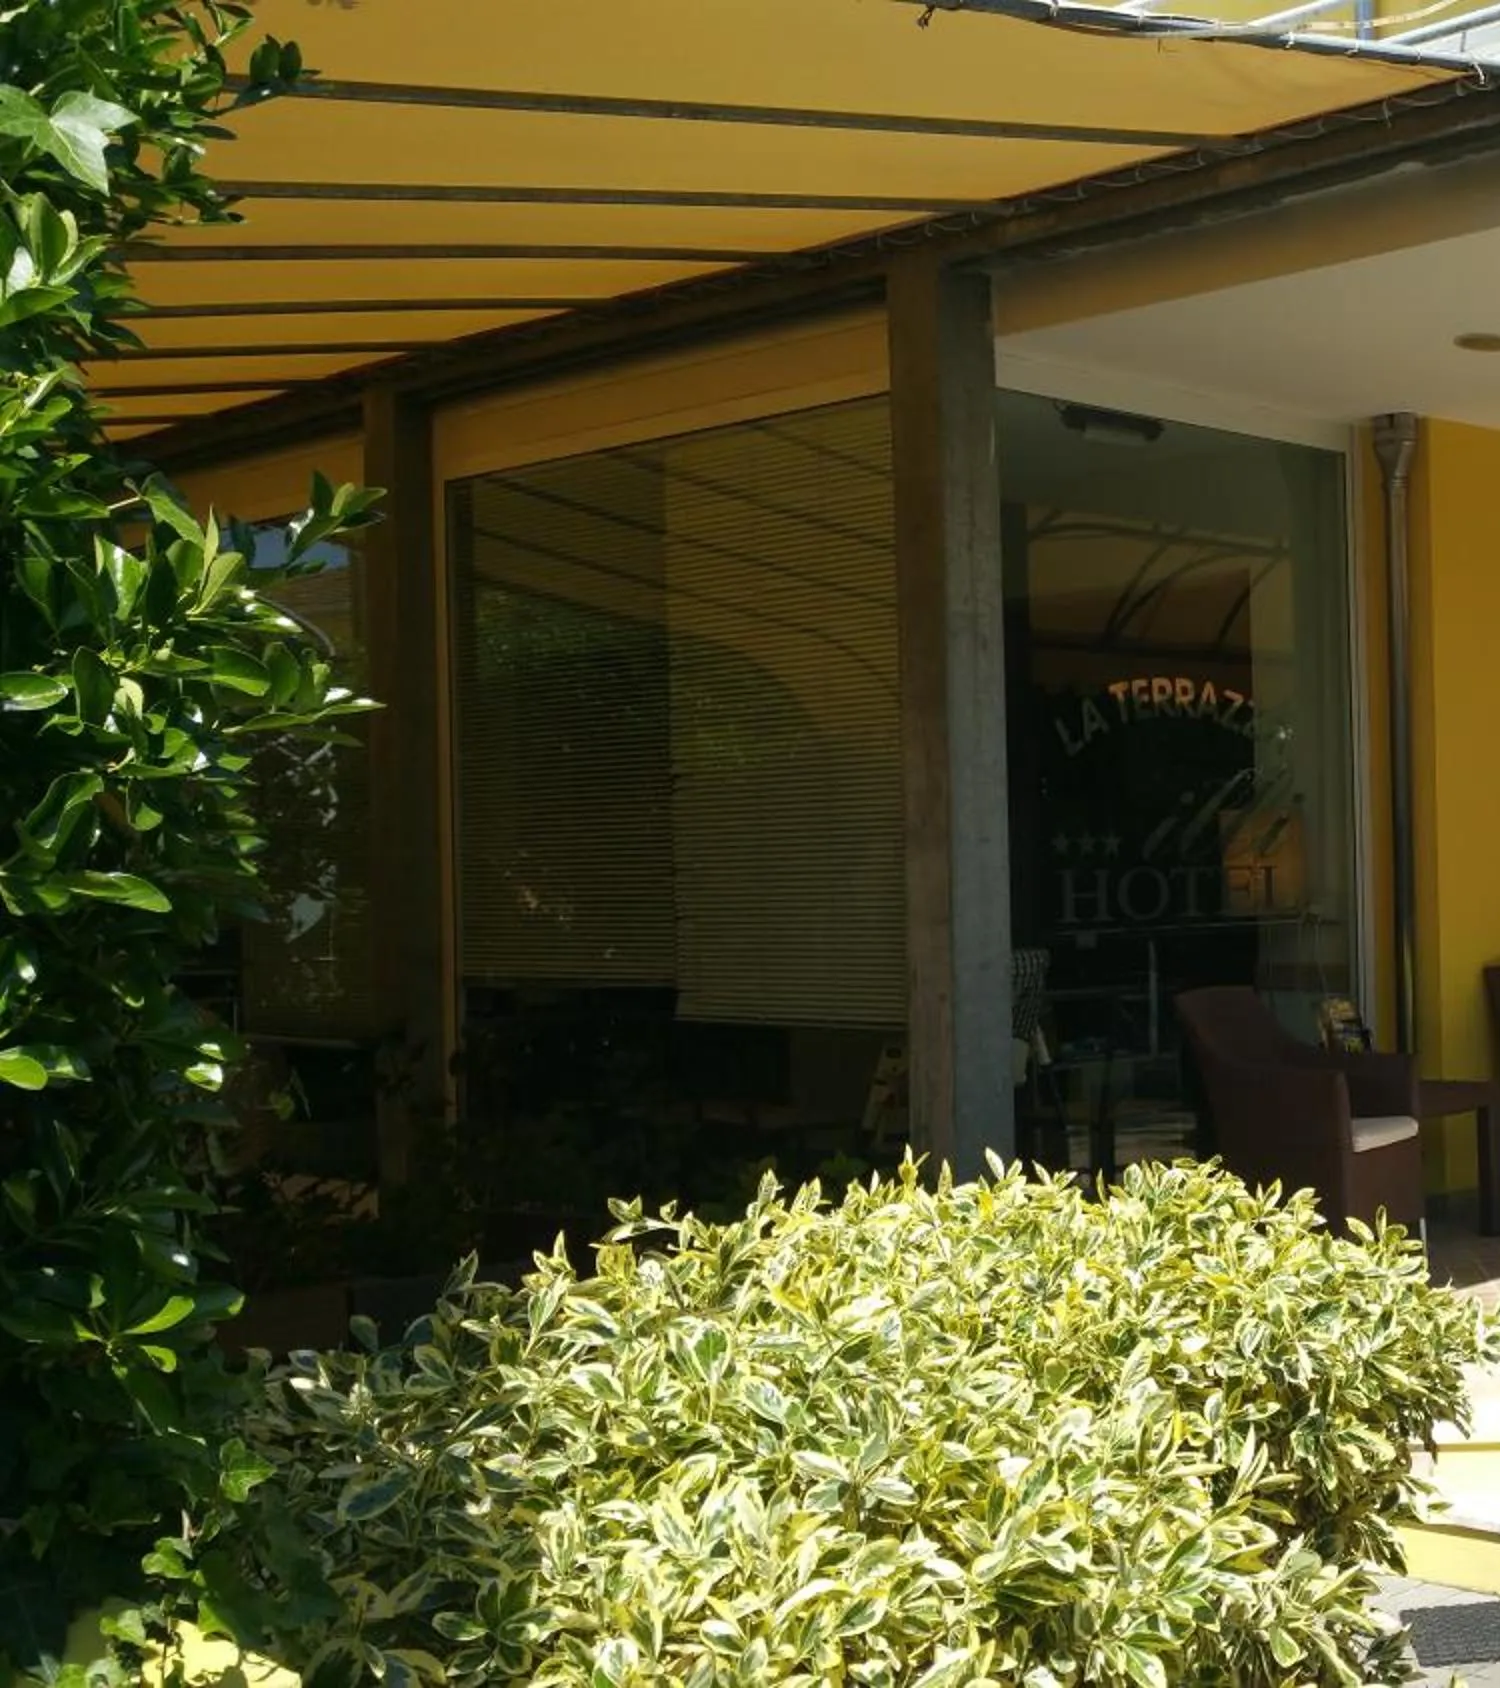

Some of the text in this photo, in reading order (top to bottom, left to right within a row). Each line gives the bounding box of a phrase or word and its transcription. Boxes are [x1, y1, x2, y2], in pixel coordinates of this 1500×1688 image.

[1054, 677, 1268, 757] LA TERRAZ
[1053, 865, 1301, 925] HOTEL
